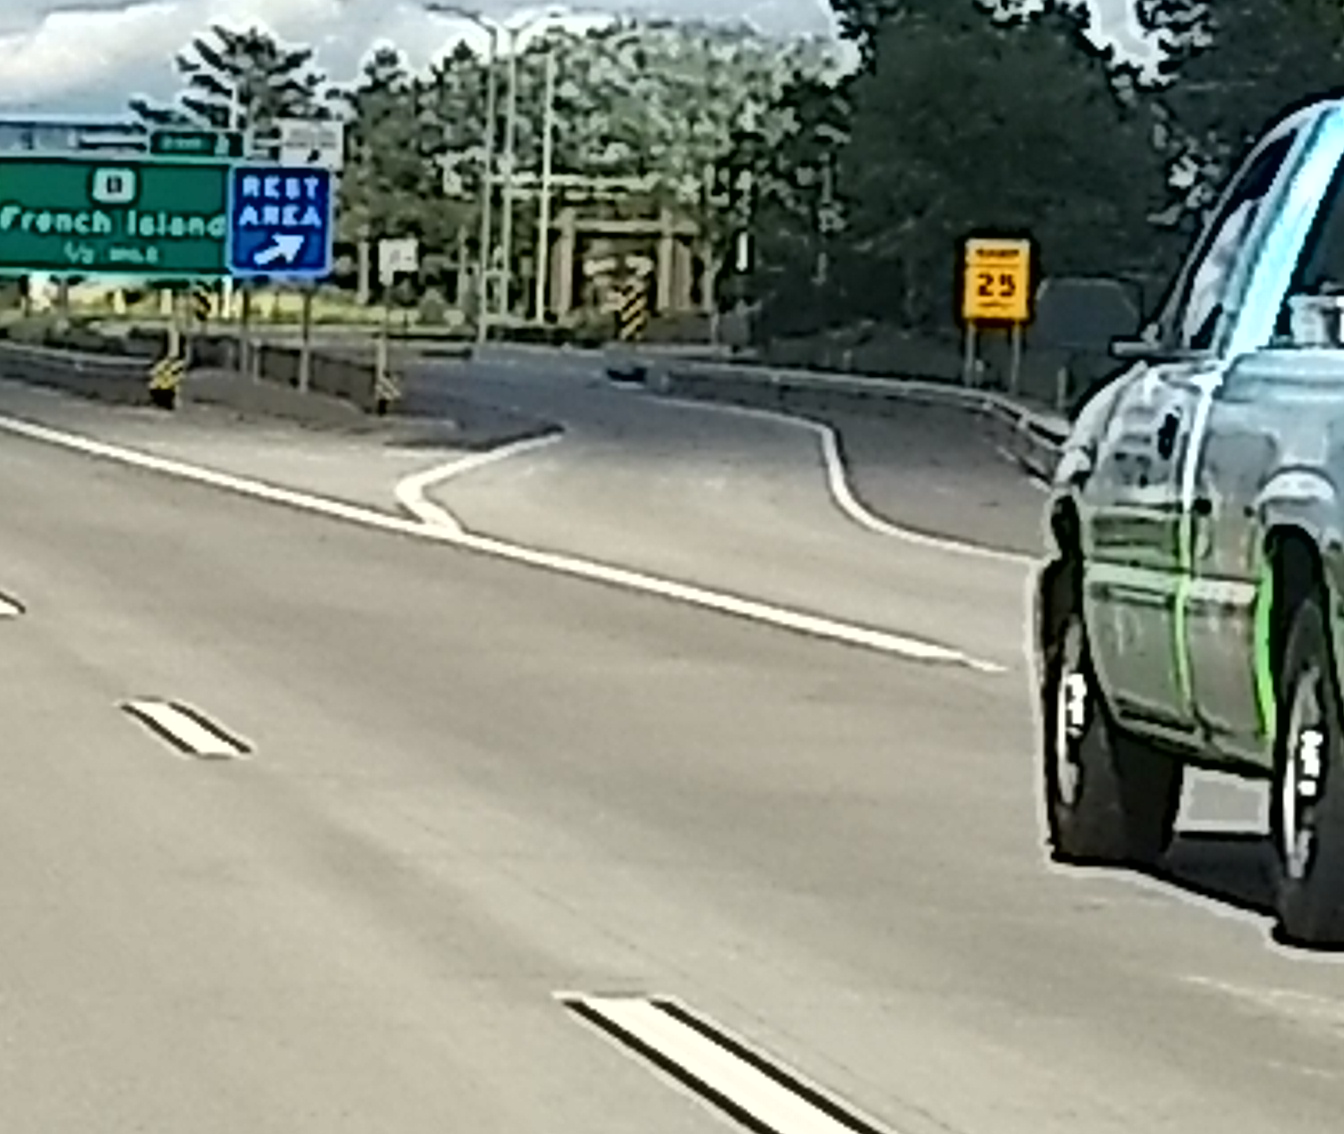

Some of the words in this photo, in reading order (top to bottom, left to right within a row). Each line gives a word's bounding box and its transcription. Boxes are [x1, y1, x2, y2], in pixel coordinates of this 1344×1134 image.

[242, 175, 320, 200] REST
[0, 205, 112, 234] French
[127, 209, 226, 237] Island
[238, 205, 323, 228] AREA
[977, 273, 1016, 297] 25
